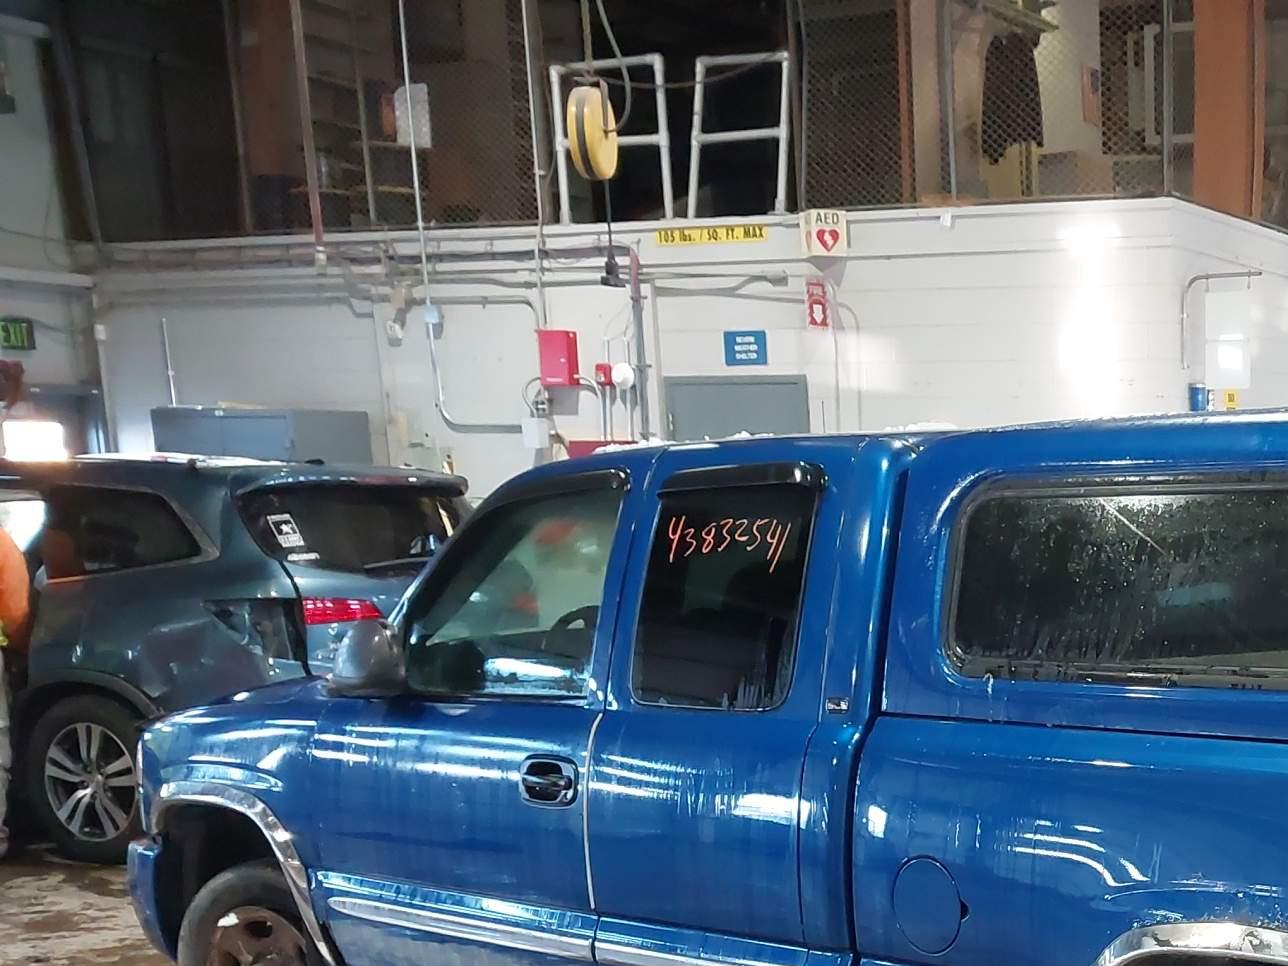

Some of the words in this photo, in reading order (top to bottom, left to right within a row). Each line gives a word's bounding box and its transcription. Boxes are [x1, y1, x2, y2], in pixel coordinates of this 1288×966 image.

[815, 211, 840, 225] AED
[659, 230, 676, 243] 105
[680, 228, 696, 242] lbs.
[707, 227, 722, 241] SQ.
[726, 226, 740, 240] FT.
[743, 225, 764, 239] MAX
[668, 515, 792, 574] 43832541
